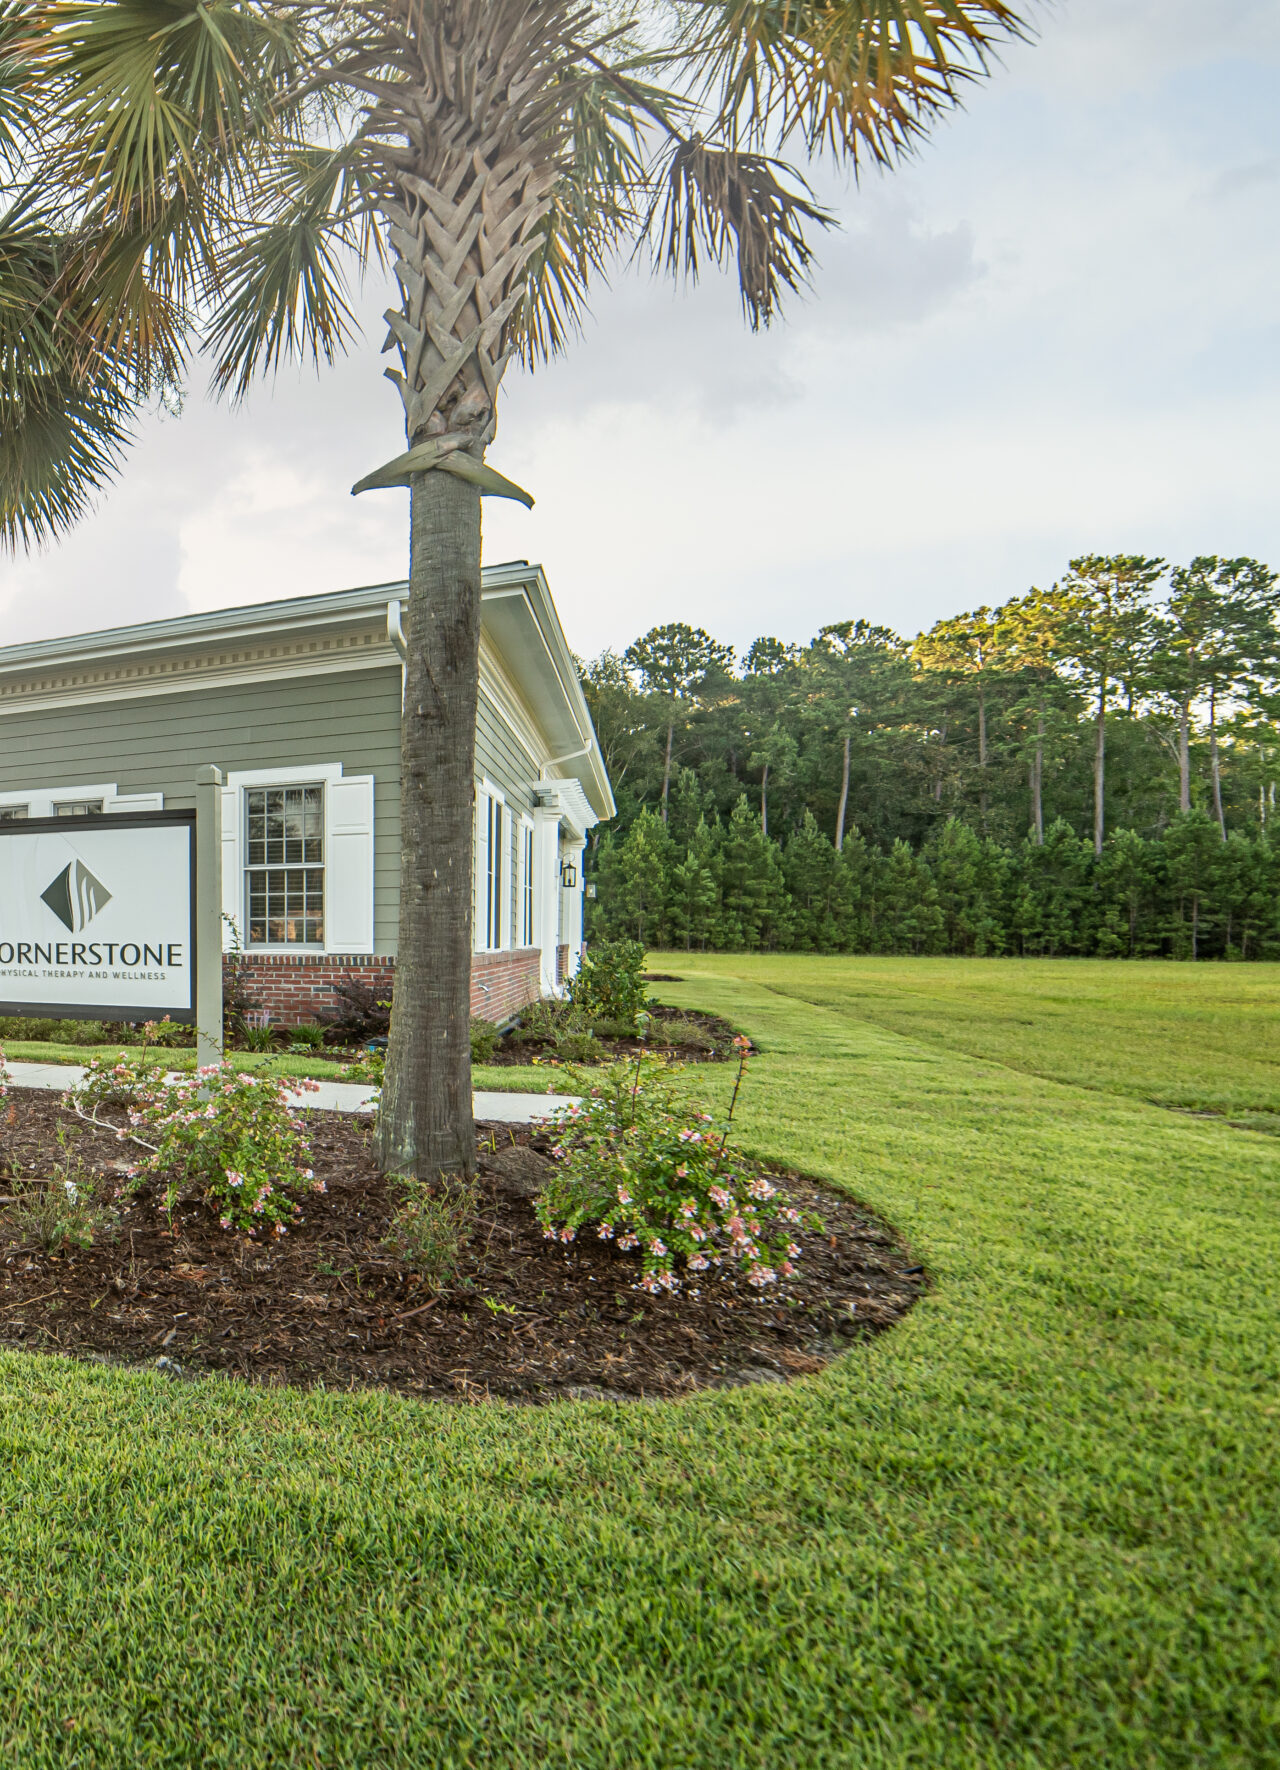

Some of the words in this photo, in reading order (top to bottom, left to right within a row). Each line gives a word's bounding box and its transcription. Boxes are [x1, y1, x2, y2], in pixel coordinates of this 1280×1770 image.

[42, 969, 85, 978] THERAPY
[88, 970, 108, 979] AND
[112, 971, 166, 980] WELLNESS
